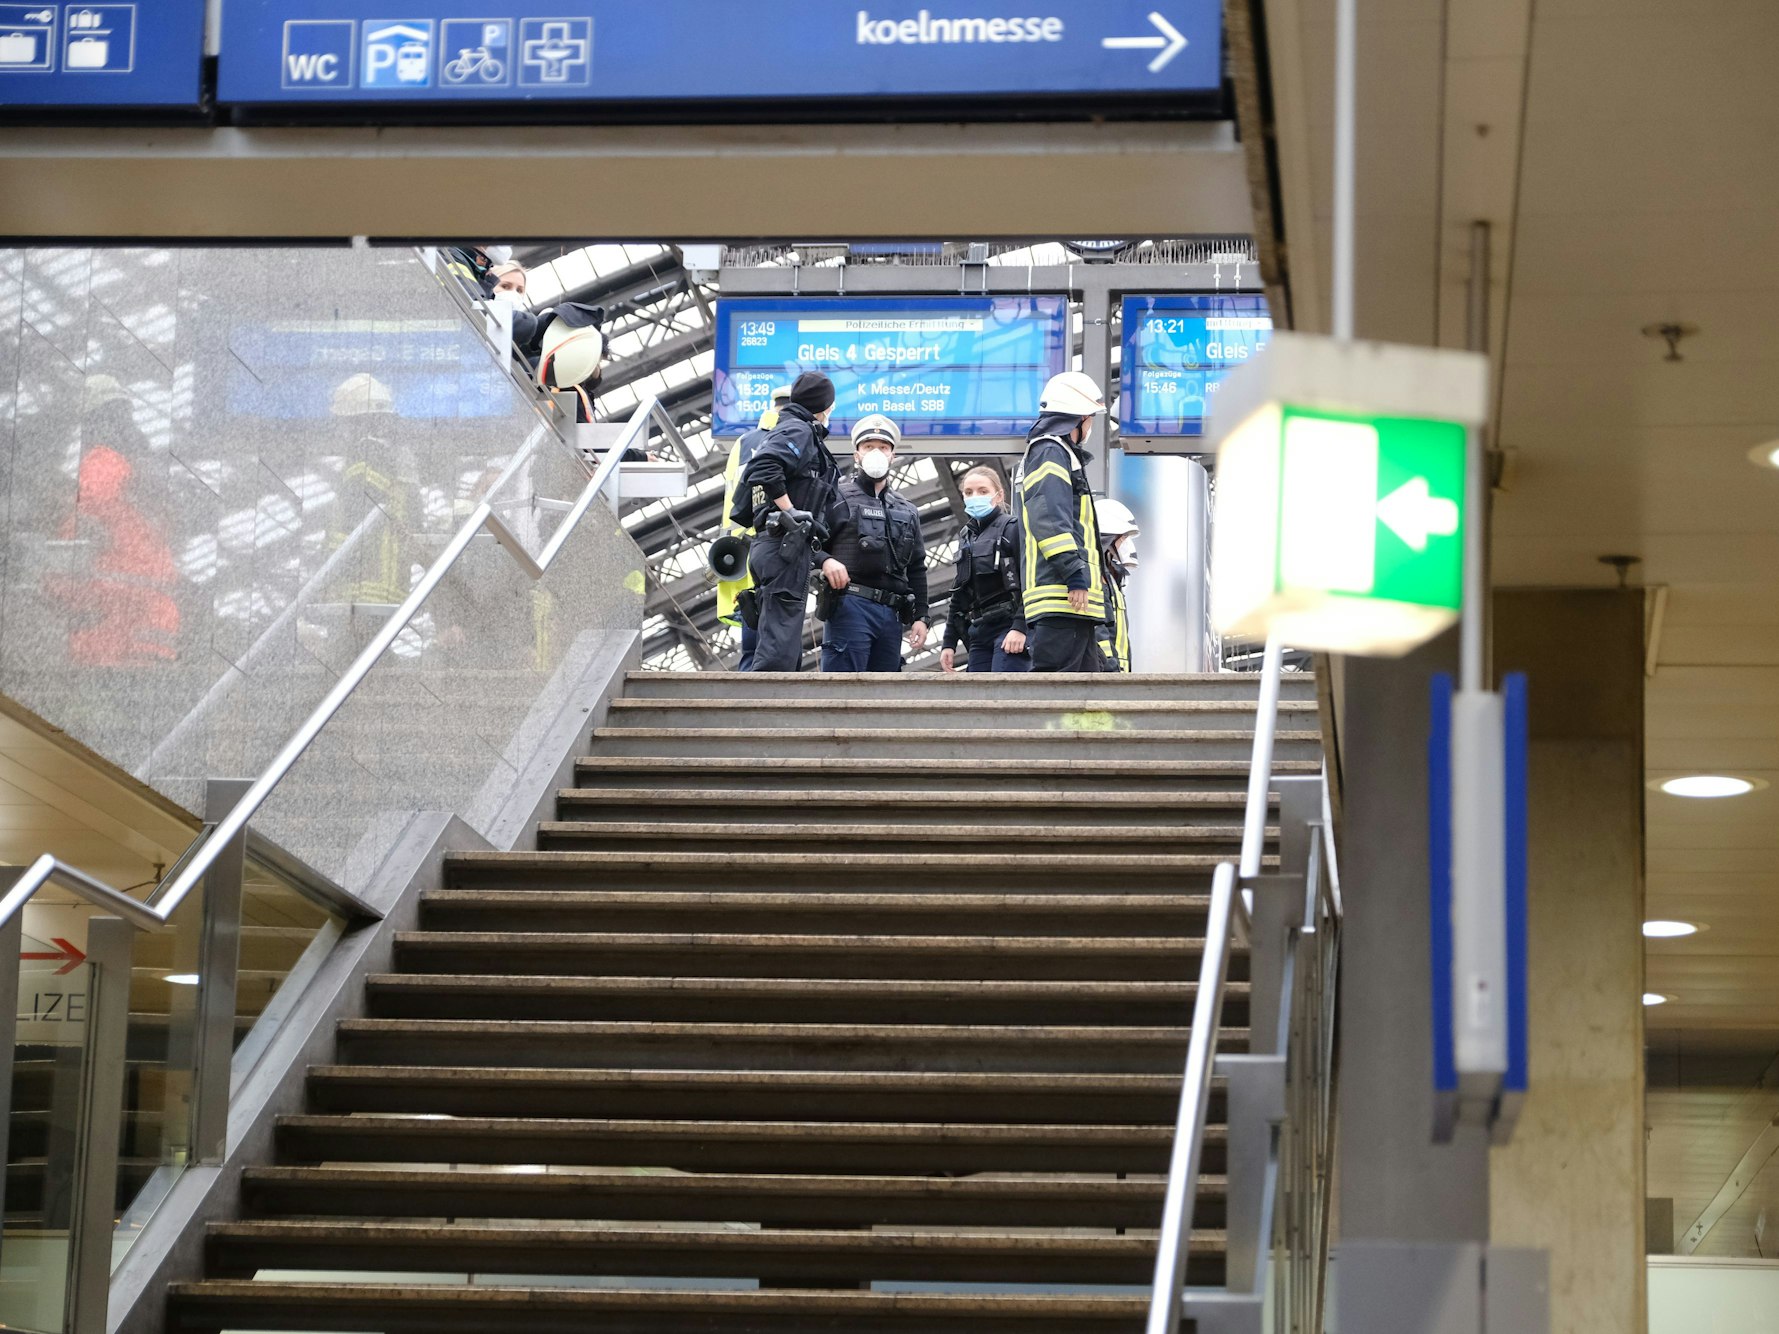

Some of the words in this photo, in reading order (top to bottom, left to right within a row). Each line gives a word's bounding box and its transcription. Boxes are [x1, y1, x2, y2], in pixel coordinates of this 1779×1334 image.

[856, 9, 1064, 44] koelnmesse
[288, 53, 339, 81] WC
[740, 321, 775, 336] 13:49
[1146, 319, 1184, 333] 13:21
[741, 336, 768, 347] 26823
[798, 343, 840, 361] Gleis
[846, 343, 857, 361] 4
[864, 343, 941, 366] Gesperrt
[1206, 342, 1249, 359] Gleis
[1143, 370, 1182, 379] Folgezüge
[737, 384, 770, 396] 15:28
[857, 383, 867, 395] K
[871, 383, 951, 395] Messe/Deutz
[1144, 381, 1177, 394] 15:46
[737, 400, 769, 412] 15:04
[857, 402, 879, 412] von
[882, 399, 916, 412] Basel
[921, 399, 945, 412] SBB
